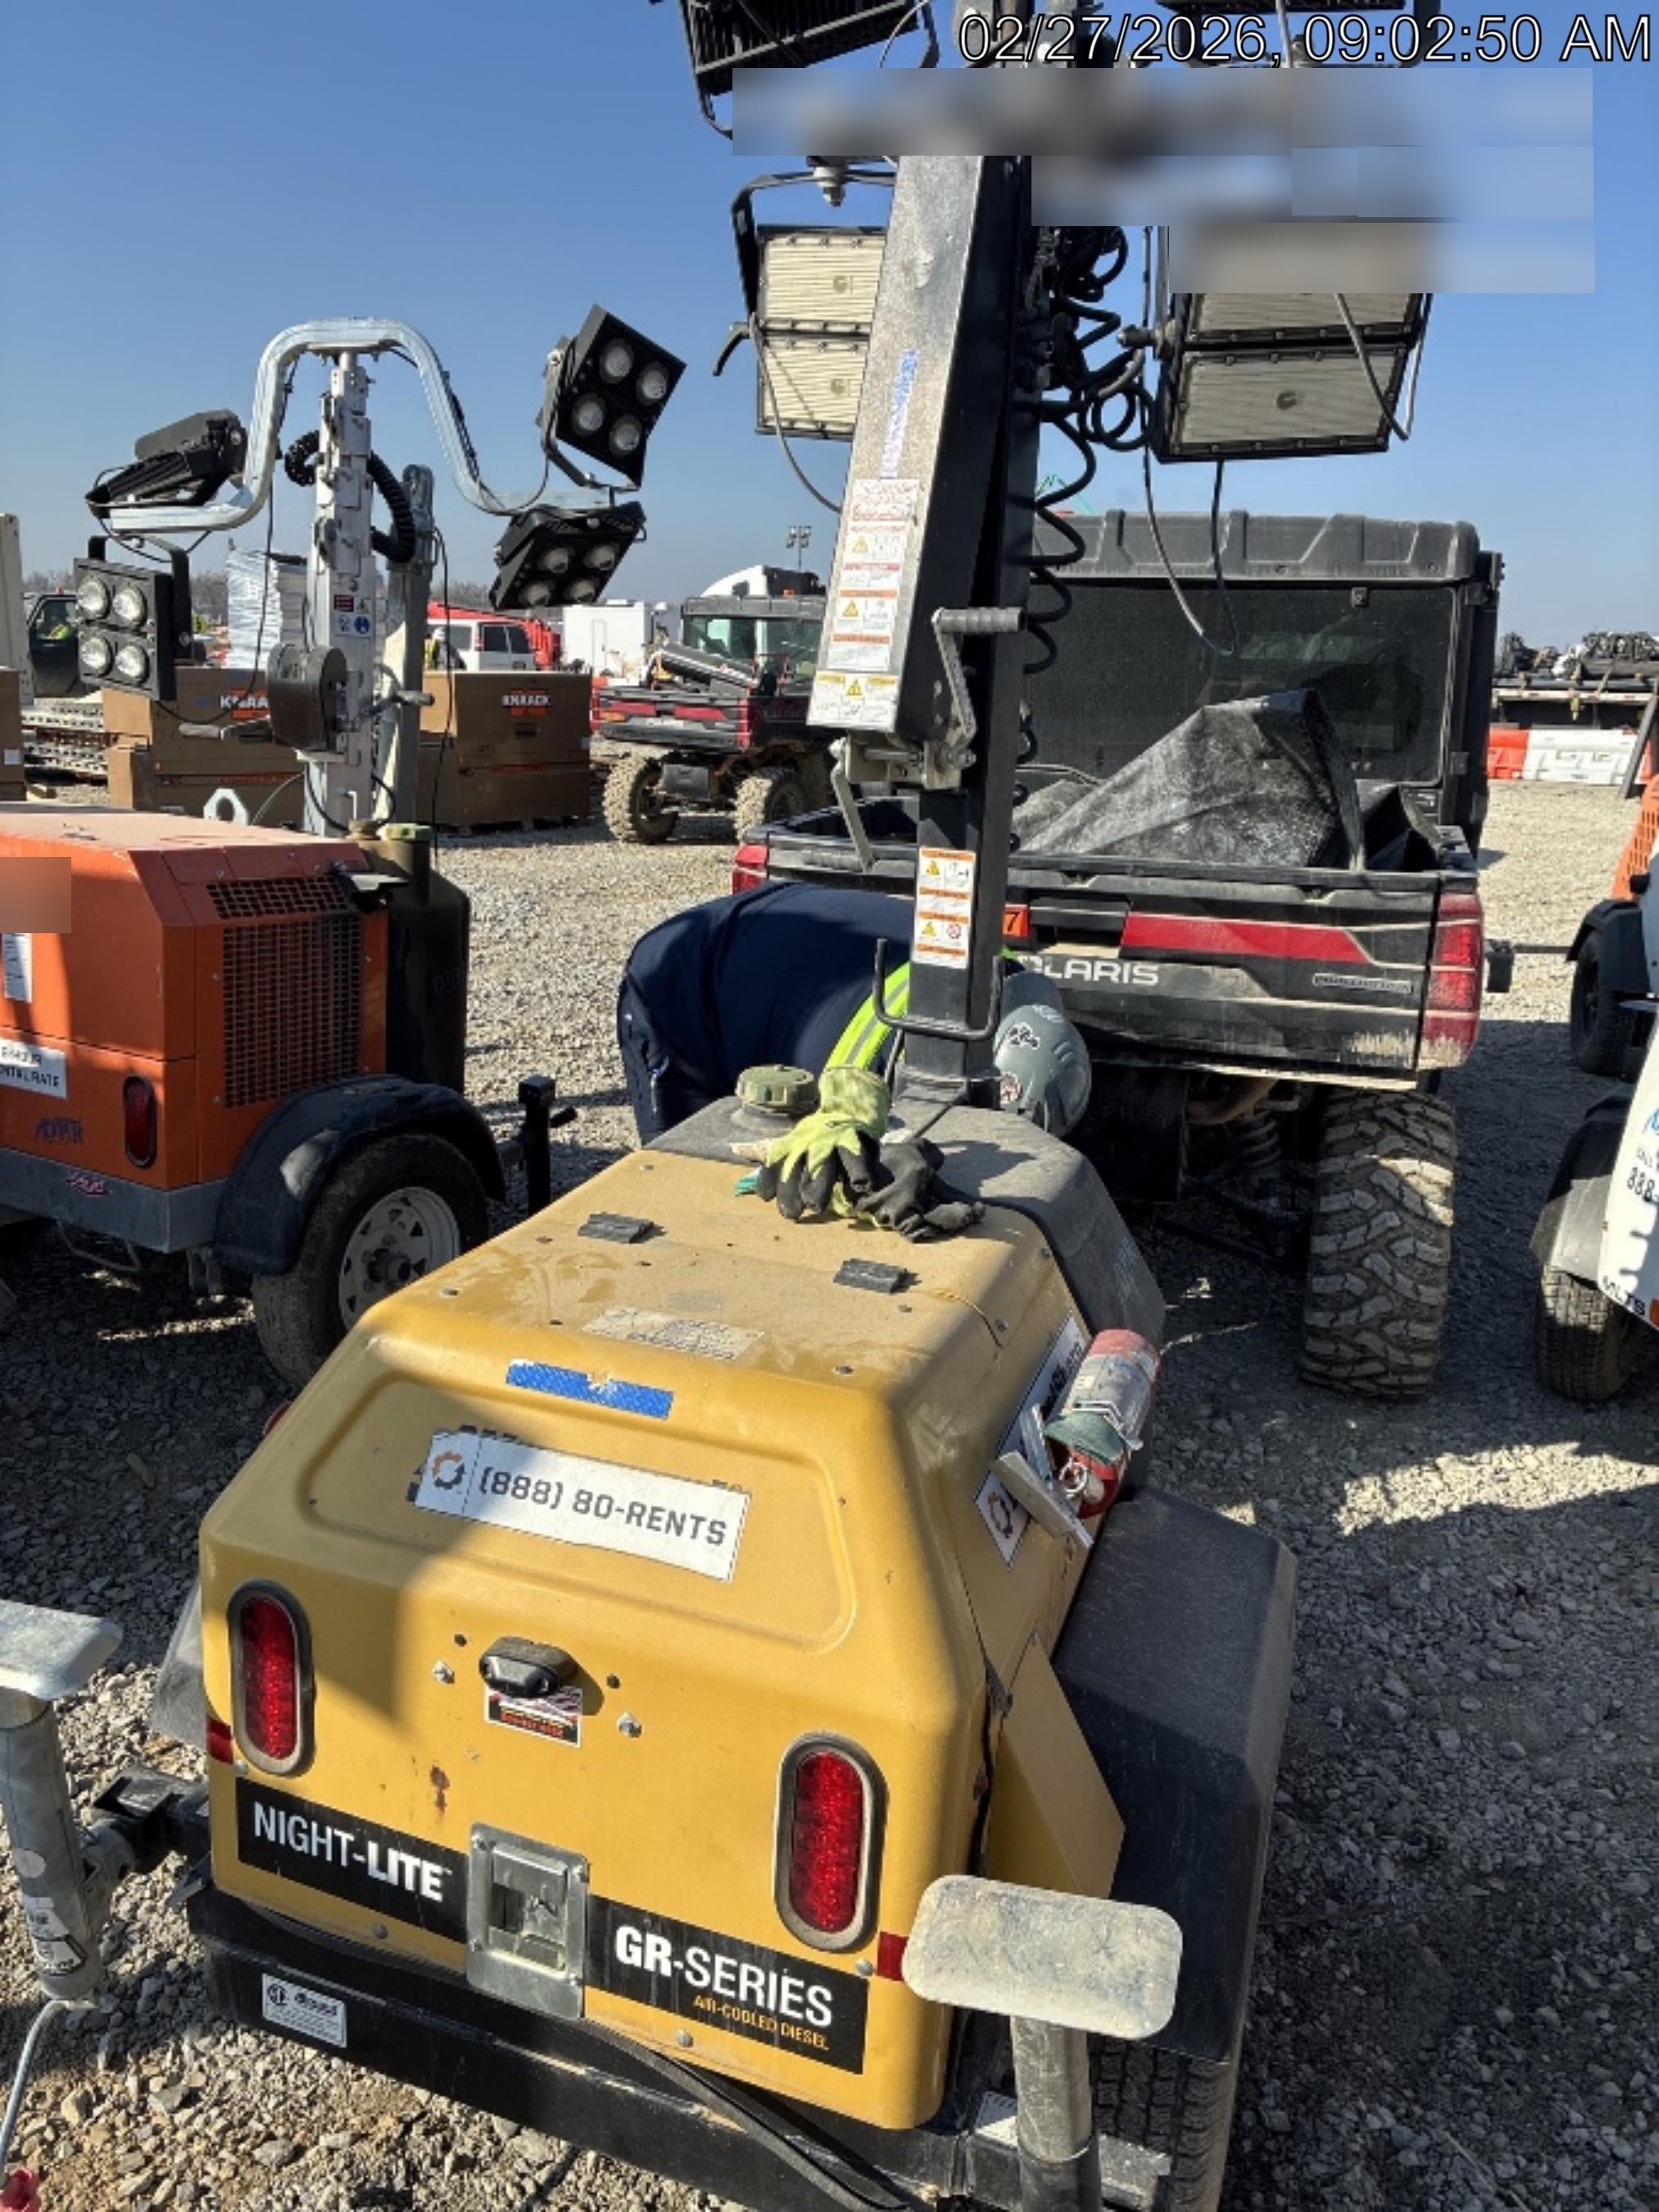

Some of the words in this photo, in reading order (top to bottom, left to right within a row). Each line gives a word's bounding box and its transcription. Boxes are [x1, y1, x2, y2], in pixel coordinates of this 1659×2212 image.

[478, 1466, 564, 1510] (888)
[572, 1489, 728, 1546] 80-RENTS
[614, 1924, 832, 2028] GR-SERIES
[693, 1995, 777, 2033] AIR-COOLED
[780, 2021, 829, 2051] DIESEL
